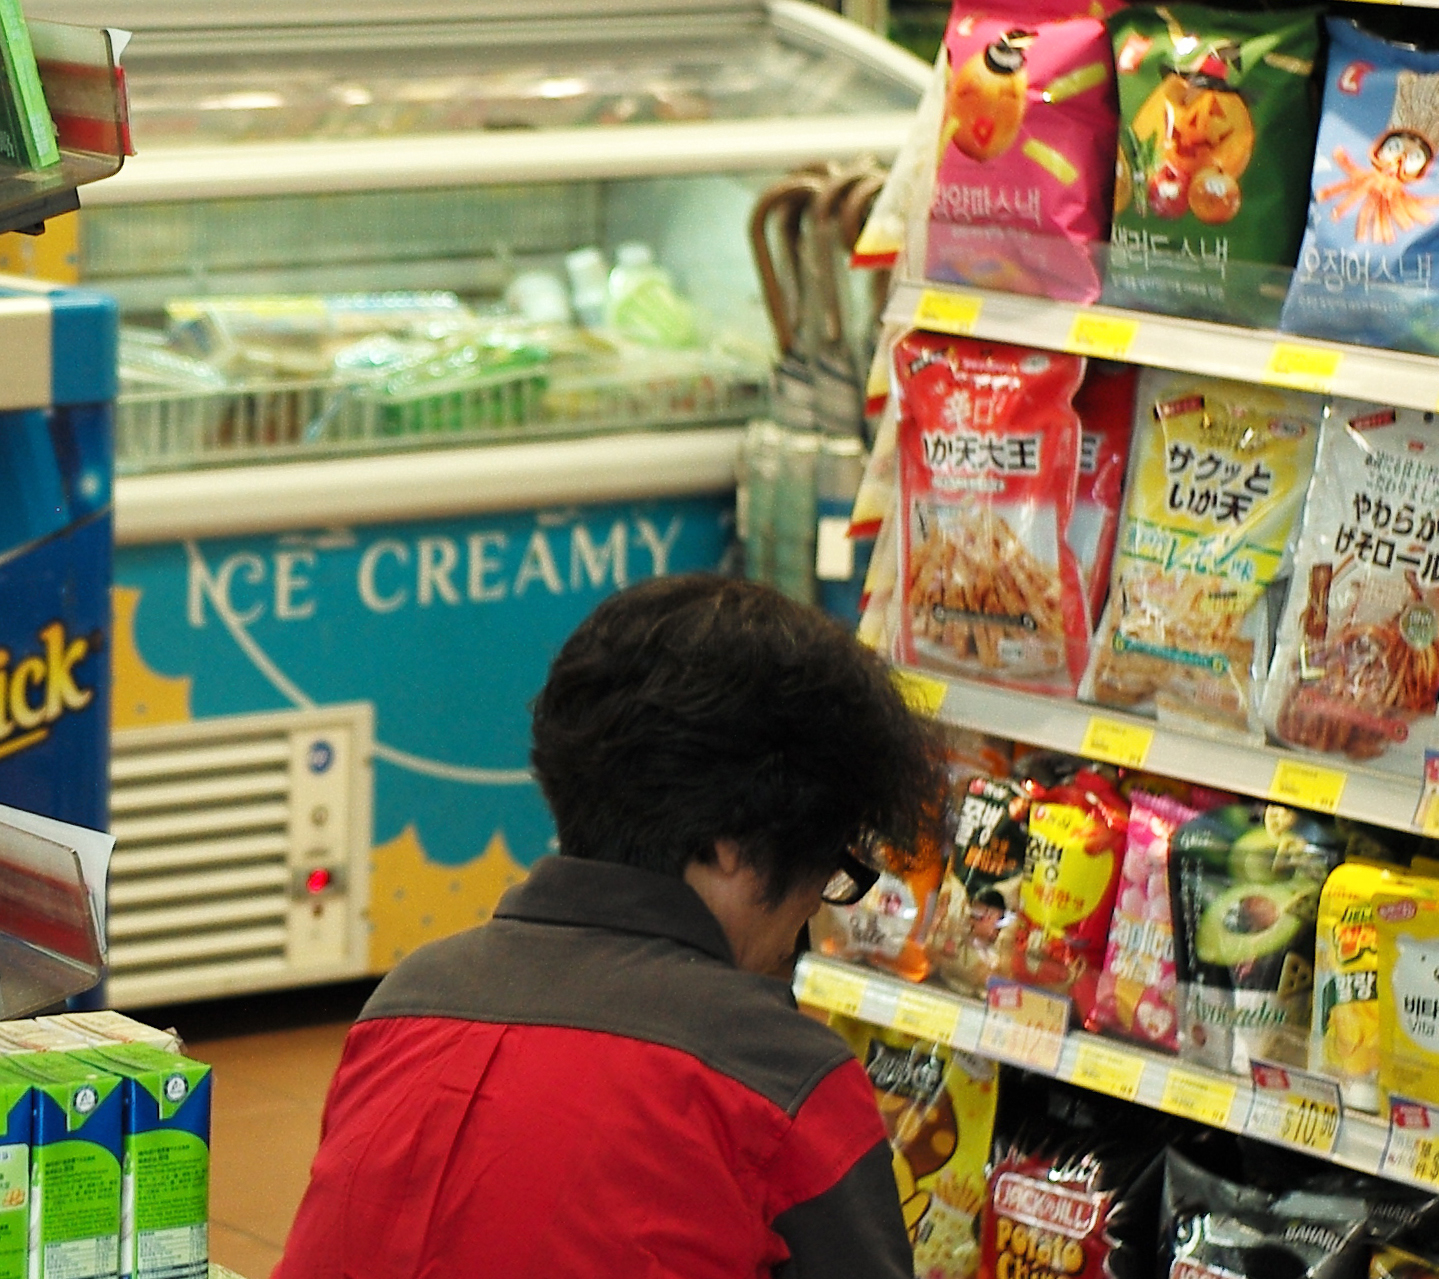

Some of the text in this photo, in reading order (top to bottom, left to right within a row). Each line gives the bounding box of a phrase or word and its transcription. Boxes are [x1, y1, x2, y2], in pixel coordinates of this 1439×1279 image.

[1167, 443, 1273, 497] サクッと
[1165, 480, 1256, 525] いか天
[356, 518, 685, 613] CREAMY
[995, 1218, 1087, 1276] Potato
